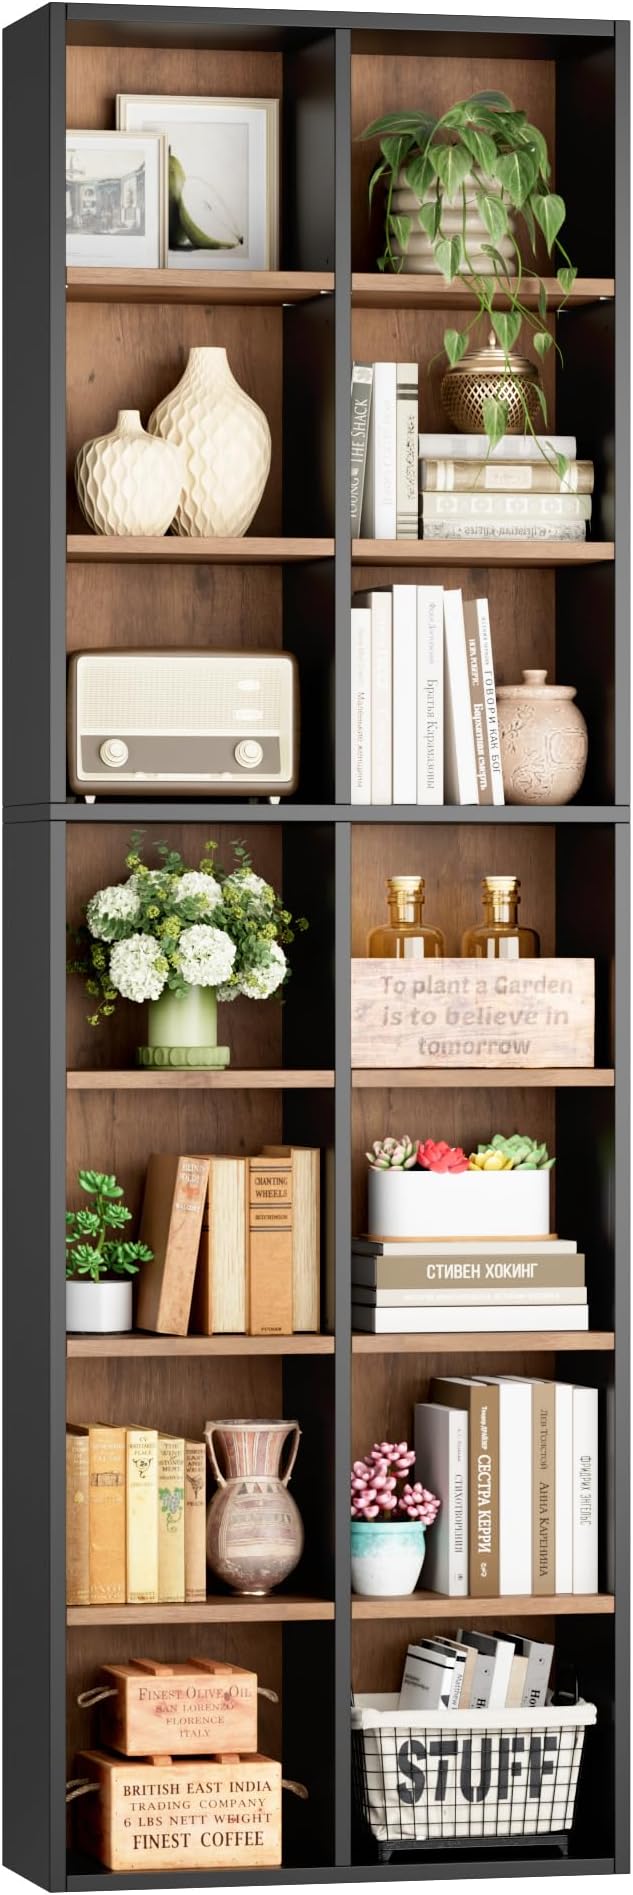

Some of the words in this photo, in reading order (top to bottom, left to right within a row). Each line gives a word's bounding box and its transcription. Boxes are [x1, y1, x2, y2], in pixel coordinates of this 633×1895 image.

[351, 399, 369, 438] SHACK
[351, 440, 365, 463] THE
[424, 679, 438, 718] Братья
[484, 670, 497, 724] ГОВОРИ
[490, 728, 498, 749] КАК
[424, 721, 438, 789] Карамазовы
[491, 754, 501, 775] БОГ
[381, 976, 406, 995] To
[412, 975, 469, 999] plant
[475, 979, 489, 995] a
[494, 975, 573, 995] Garden
[382, 1006, 402, 1026] is
[411, 1007, 437, 1026] to
[445, 1006, 538, 1026] believe
[546, 1007, 569, 1025] in
[418, 1038, 531, 1056] tomorrow
[254, 1176, 288, 1186] CHANTING
[255, 1189, 288, 1198] WHEELS
[426, 1263, 480, 1280] СТИВЕН
[485, 1262, 538, 1279] ХОКИНГ
[478, 1454, 492, 1507] СЕСТРА
[580, 1455, 592, 1490] ФРИДРИХ
[580, 1494, 592, 1526] ЭНГЕЛЬС
[478, 1510, 492, 1553] КЕРРИ
[138, 1687, 183, 1701] FINEST
[186, 1686, 224, 1701] OLIVE
[229, 1685, 251, 1698] OIL
[156, 1704, 178, 1713] SAN
[183, 1702, 234, 1713] LORENZO
[166, 1716, 225, 1726] FLORENCE
[179, 1728, 211, 1738] ITALY
[397, 1737, 557, 1804] STUFF
[123, 1783, 180, 1797] BRITISH
[187, 1782, 223, 1794] EAST
[229, 1780, 272, 1793] INDIA
[129, 1800, 191, 1812] TRADING
[199, 1798, 266, 1810] COMPANY
[124, 1817, 132, 1828] 6
[138, 1816, 163, 1827] LBS
[169, 1815, 208, 1826] NETT
[214, 1812, 273, 1825] WEIGHT
[133, 1832, 191, 1850] FINEST
[200, 1831, 264, 1848] COFFEE
